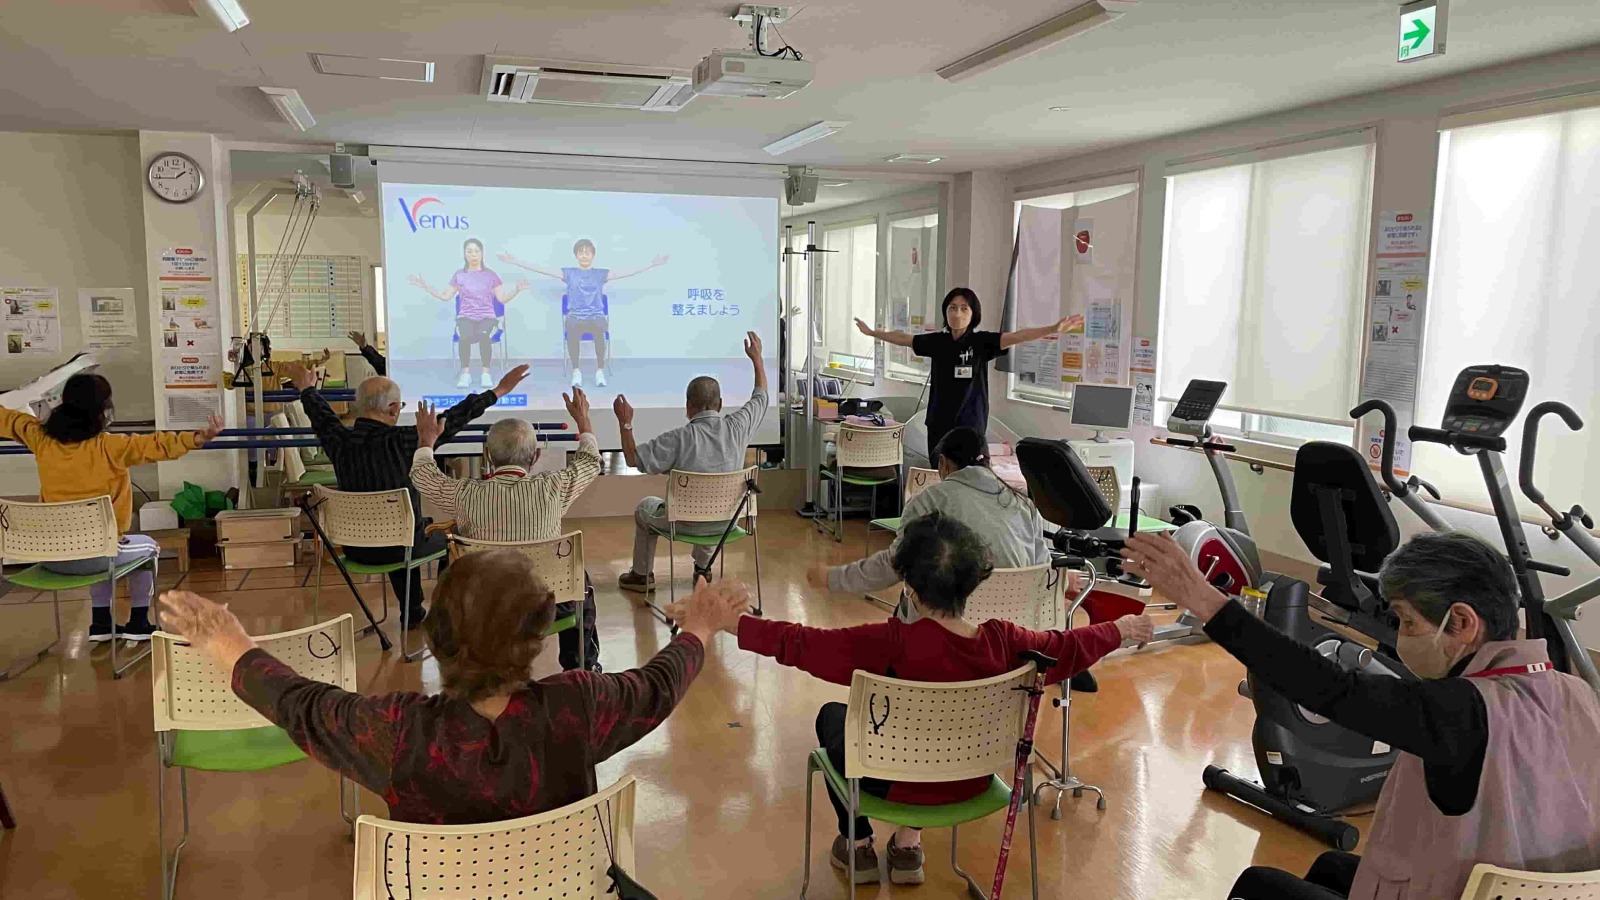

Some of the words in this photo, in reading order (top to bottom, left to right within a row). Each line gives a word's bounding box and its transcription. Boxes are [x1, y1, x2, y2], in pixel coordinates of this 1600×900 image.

[171, 158, 180, 166] 12
[398, 197, 470, 233] Venus
[687, 288, 725, 301] 呼吸を
[671, 303, 740, 316] 整えましょう
